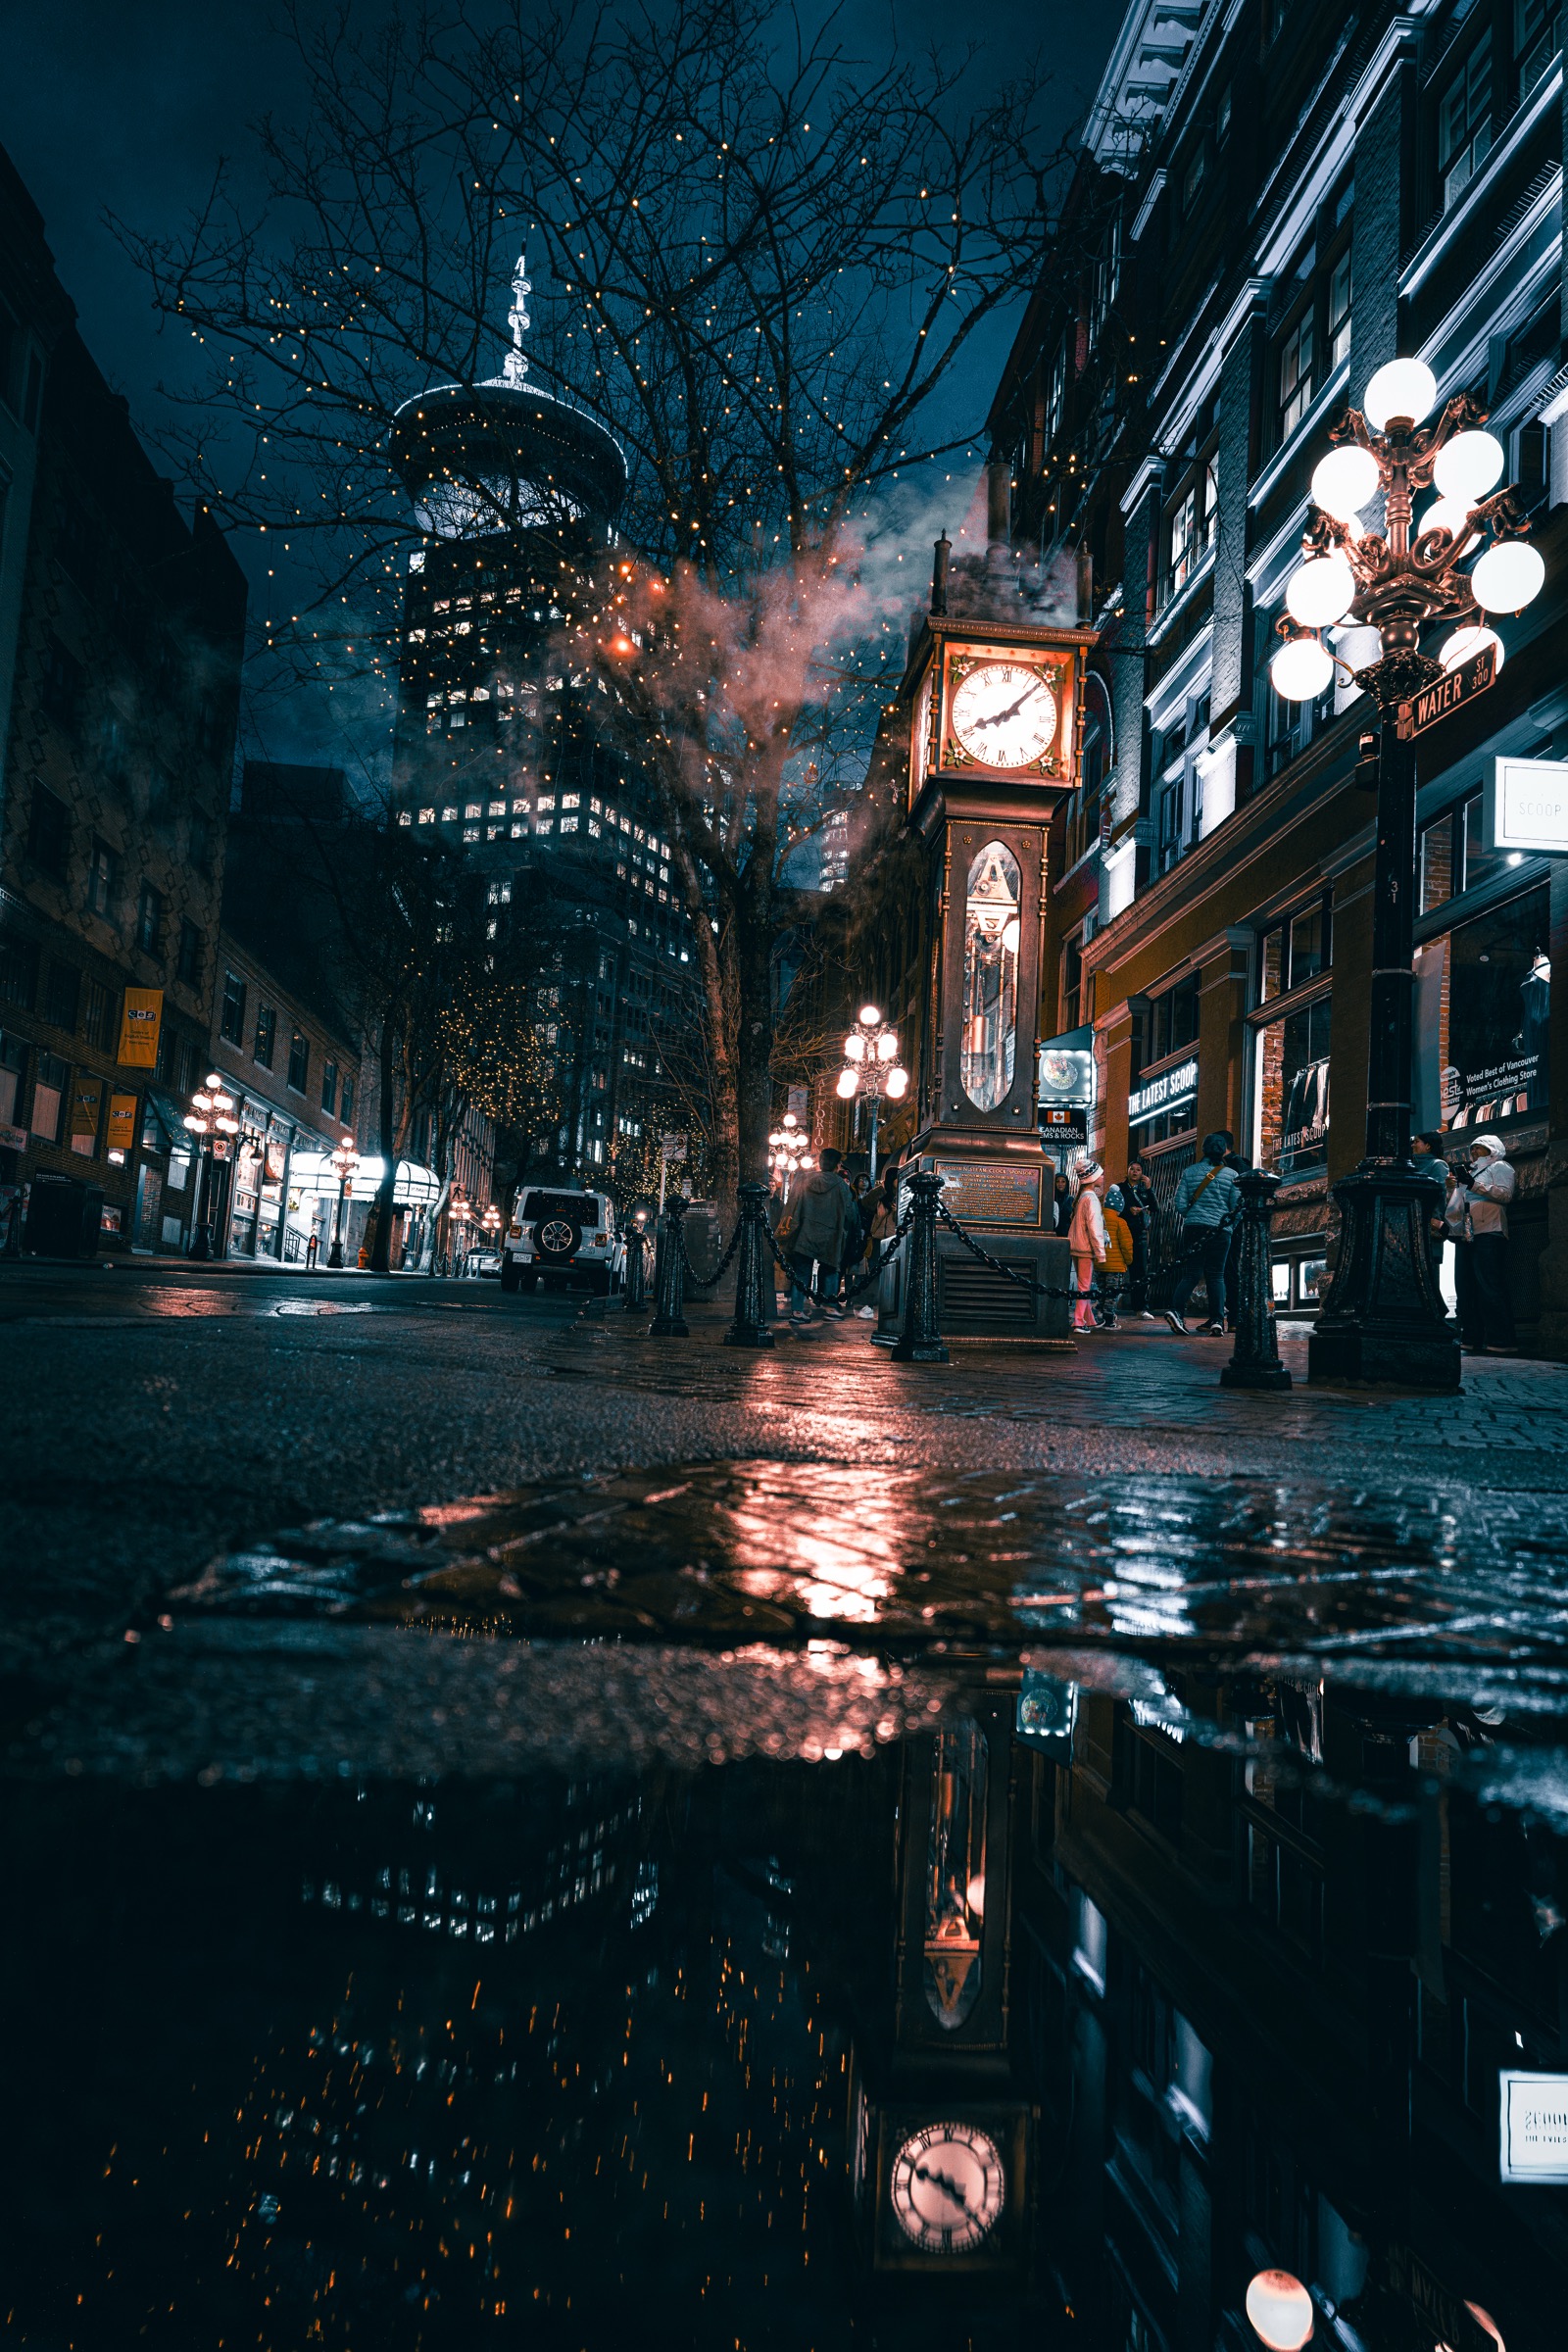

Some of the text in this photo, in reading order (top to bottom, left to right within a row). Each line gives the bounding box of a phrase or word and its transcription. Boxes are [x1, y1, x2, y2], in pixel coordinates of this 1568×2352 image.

[1472, 668, 1489, 689] 300
[1476, 657, 1485, 672] ST
[1418, 673, 1462, 724] WATER
[1519, 803, 1561, 816] SCOOP
[1466, 1070, 1484, 1084] Voted
[1485, 1066, 1497, 1078] Best
[1499, 1062, 1506, 1073] of
[1506, 1054, 1540, 1070] Vancouver
[1466, 1069, 1537, 1097] Women's Clothing Store
[1128, 1062, 1198, 1116] THE LATEST SCOOP
[814, 1101, 825, 1147] PORTO
[1284, 1130, 1303, 1149] LATEST
[1305, 1124, 1326, 1142] SCOOP
